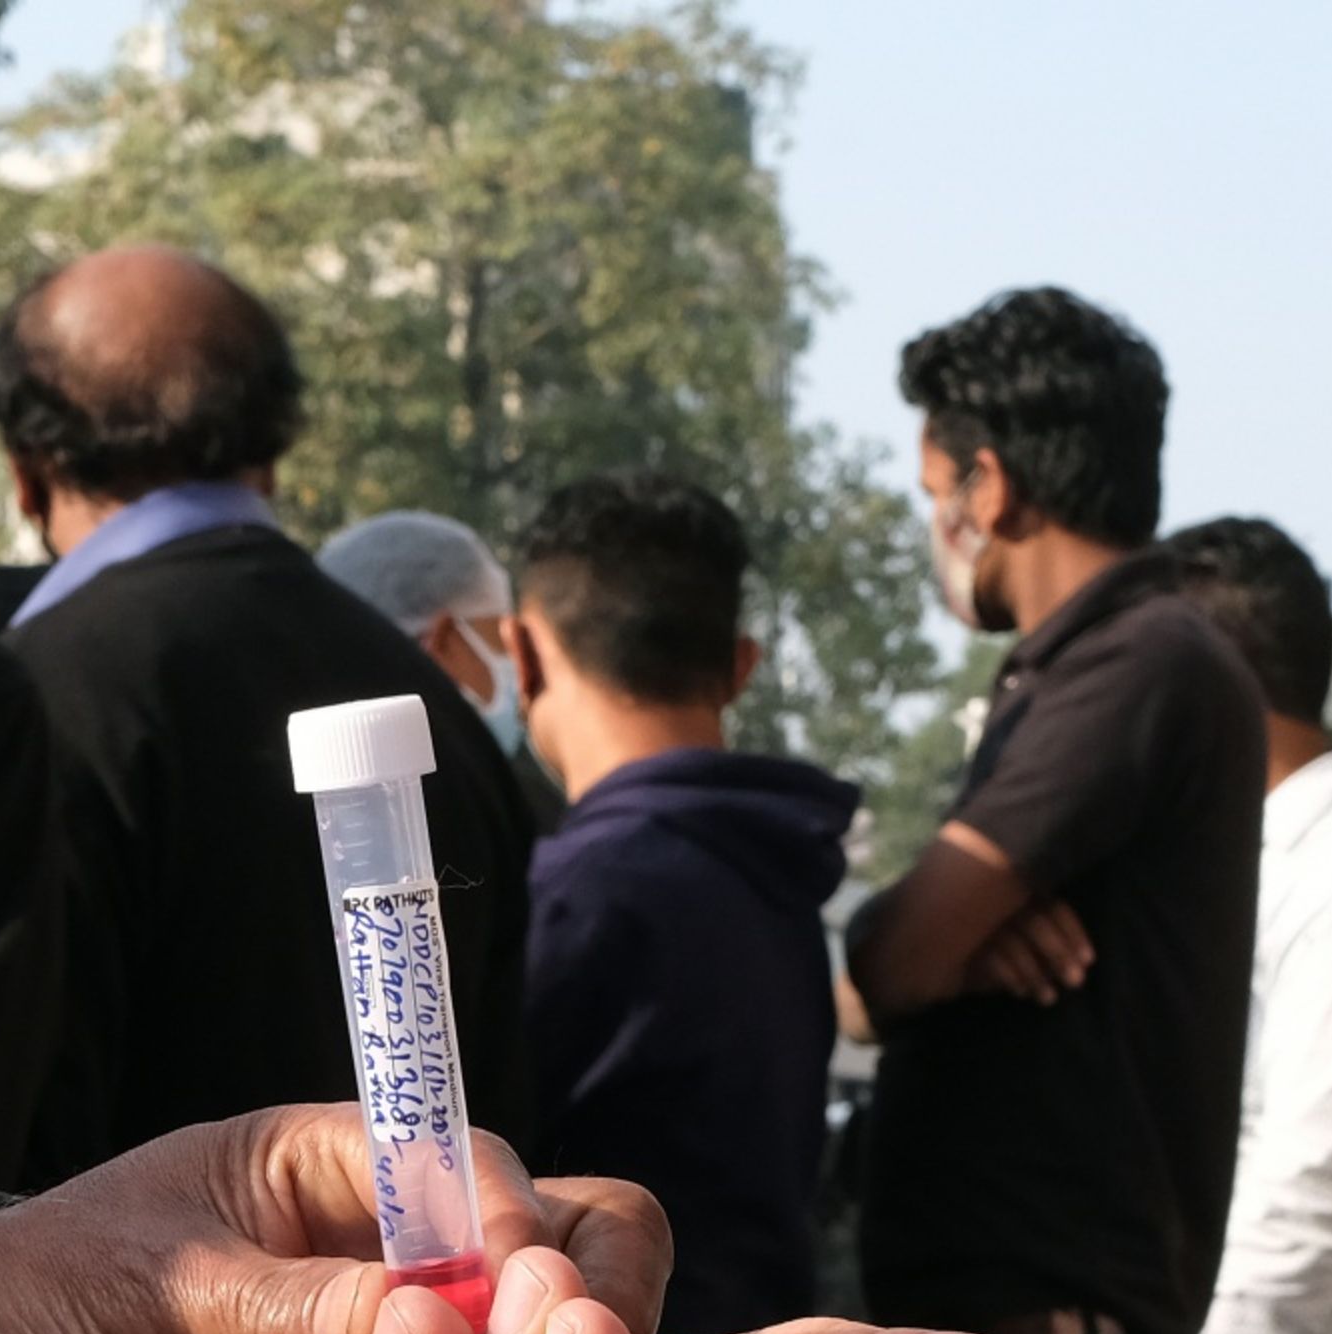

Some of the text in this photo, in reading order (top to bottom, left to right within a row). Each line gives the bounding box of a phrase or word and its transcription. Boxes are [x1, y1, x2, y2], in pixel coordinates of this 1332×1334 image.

[373, 888, 435, 910] PATHKITS
[434, 954, 445, 987] Viral
[438, 992, 453, 1063] Transport
[447, 1063, 459, 1118] Medium
